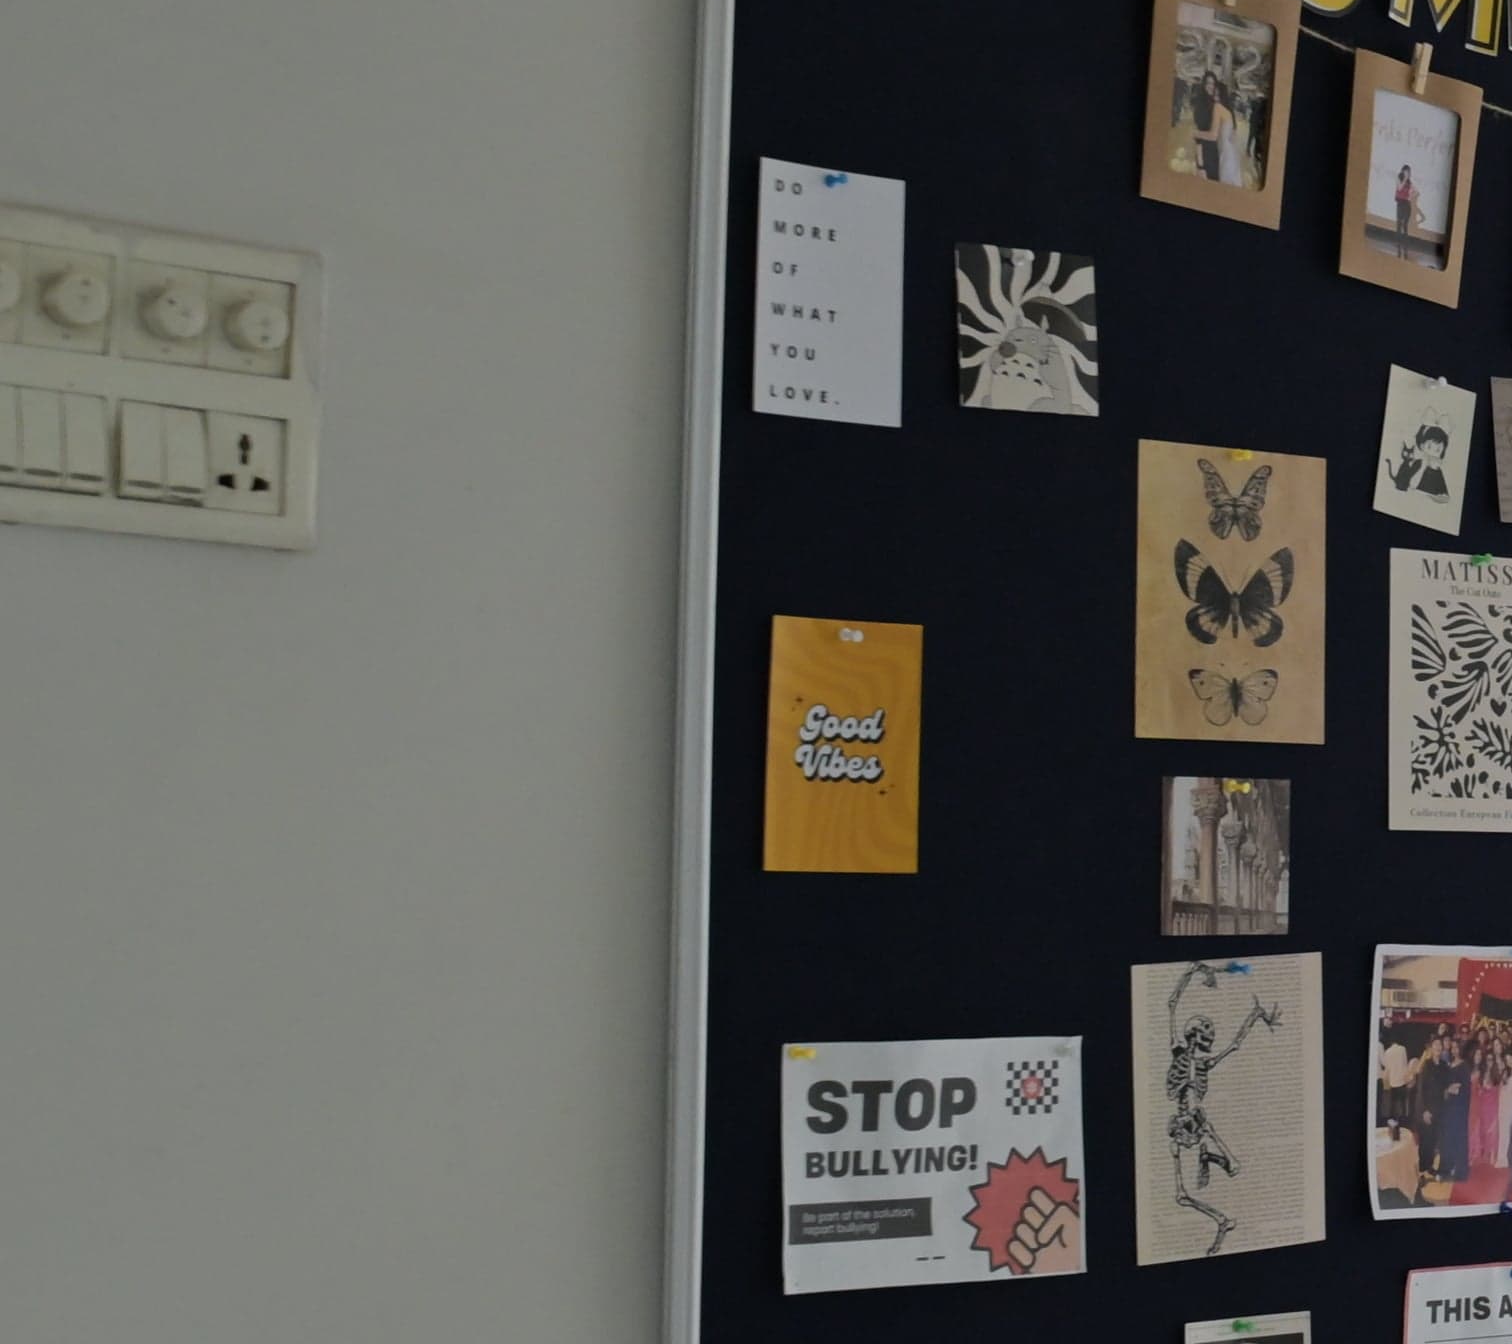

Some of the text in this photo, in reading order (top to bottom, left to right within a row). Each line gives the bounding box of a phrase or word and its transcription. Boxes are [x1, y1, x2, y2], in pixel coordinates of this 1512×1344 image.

[774, 178, 804, 196] DO
[773, 220, 839, 243] MORE
[772, 261, 800, 277] OF
[772, 302, 839, 324] WHAT
[769, 343, 817, 362] YOU
[769, 384, 841, 406] LOVE.
[799, 703, 886, 744] Good
[794, 743, 884, 784] Vibes
[806, 1077, 977, 1134] STOP
[805, 1144, 978, 1179] BULLYING!
[1426, 1295, 1491, 1324] THIS
